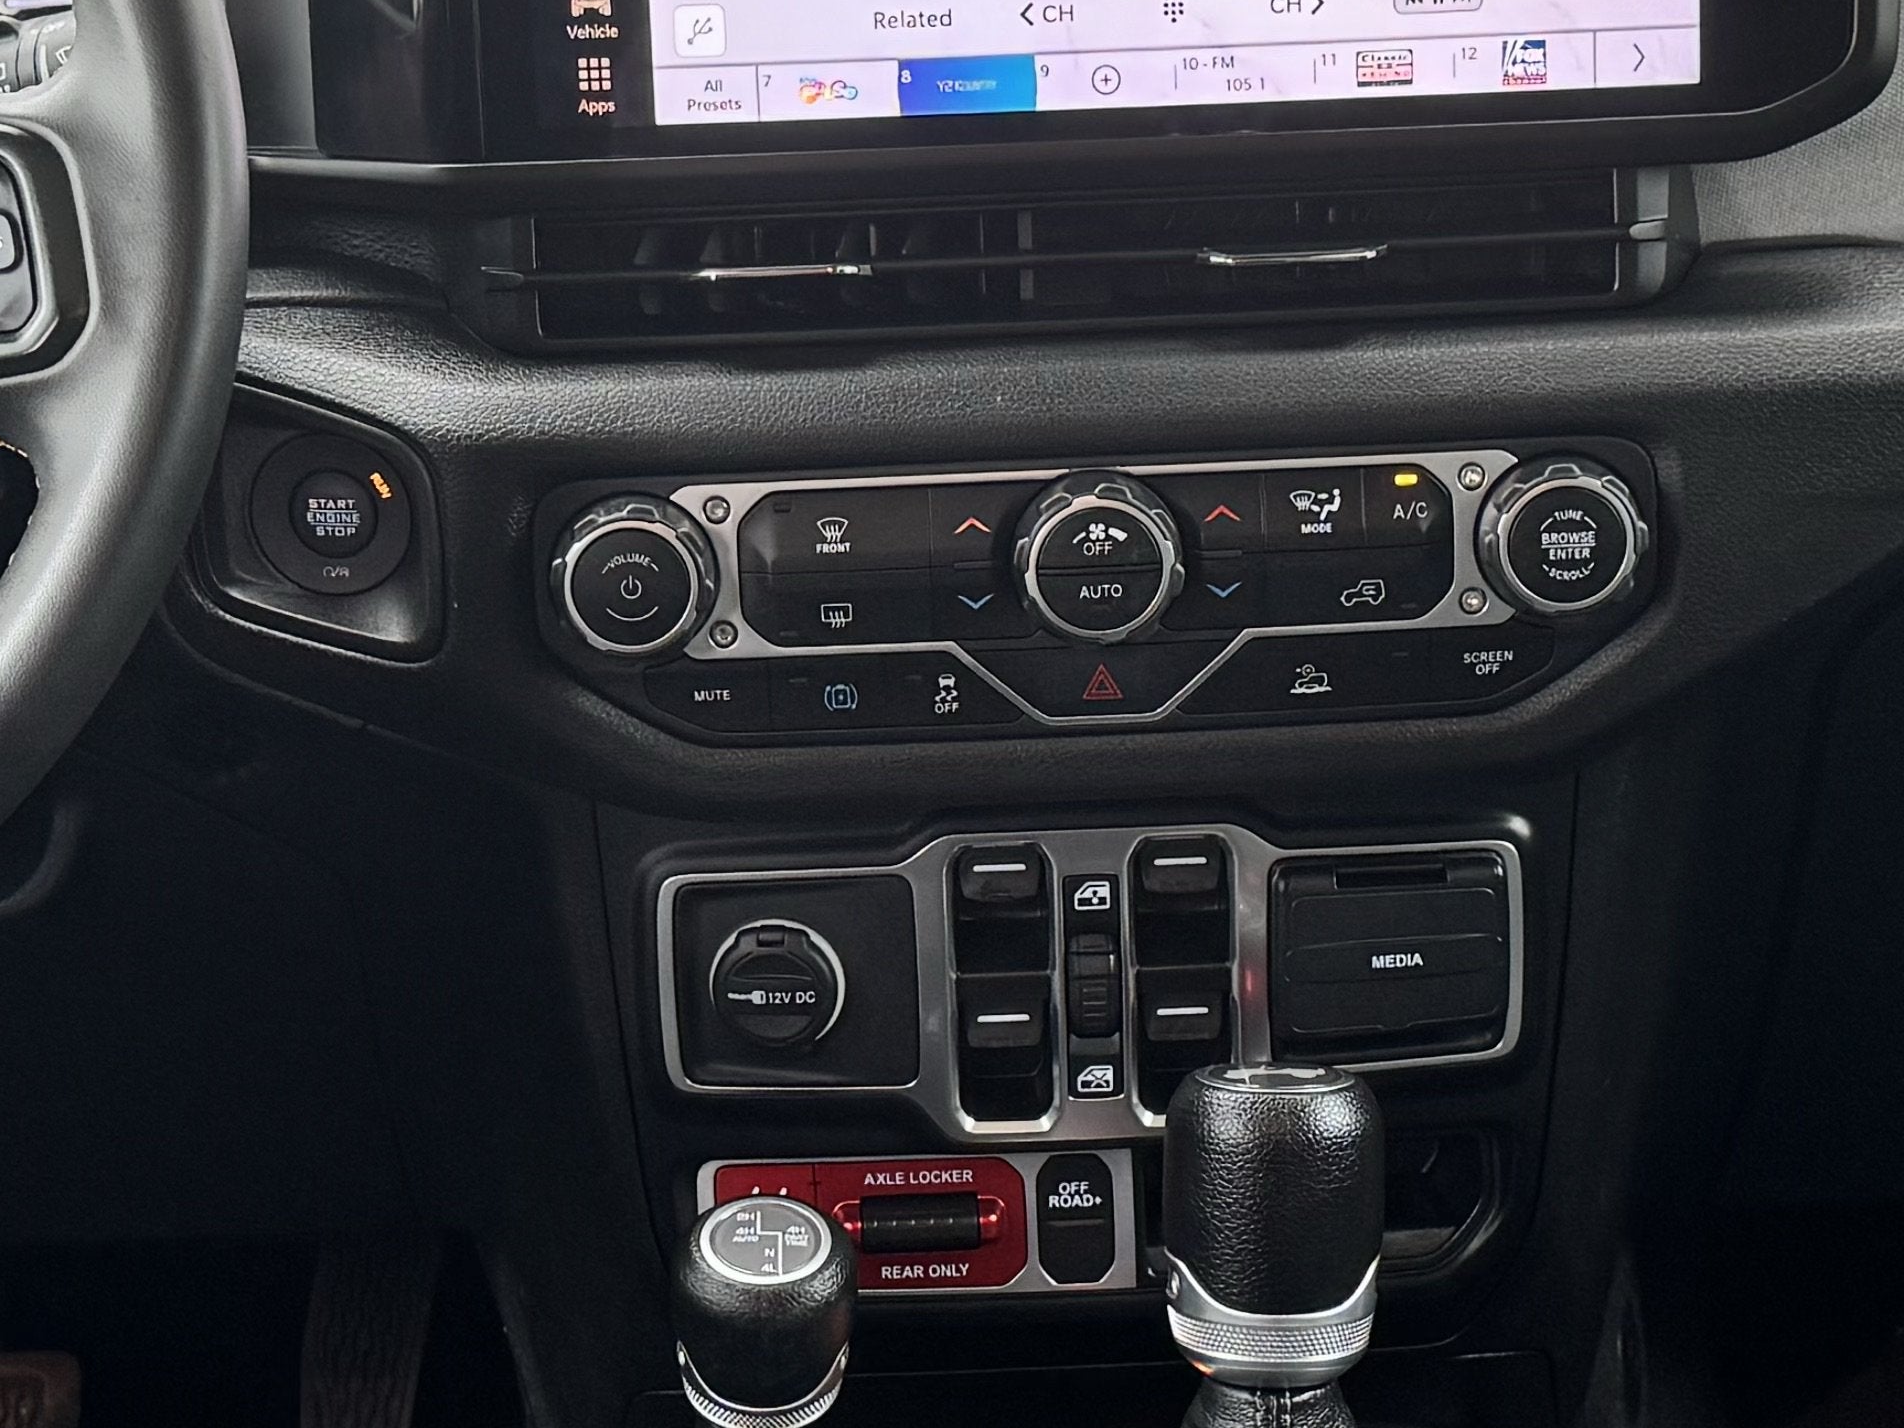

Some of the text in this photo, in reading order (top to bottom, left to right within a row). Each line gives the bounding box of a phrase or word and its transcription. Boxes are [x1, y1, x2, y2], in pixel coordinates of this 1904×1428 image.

[874, 9, 953, 31] Related
[1042, 4, 1075, 24] CH
[566, 24, 619, 40] Vehicle
[1321, 53, 1337, 67] 11
[1461, 47, 1478, 60] 12
[1182, 57, 1199, 71] 10
[1212, 55, 1235, 70] FM
[900, 69, 912, 83] 8
[1040, 64, 1050, 78] 9
[704, 79, 723, 93] All
[762, 74, 772, 88] 7
[578, 98, 616, 115] Apps
[687, 97, 742, 112] Presets
[308, 498, 356, 510] START
[1392, 502, 1428, 520] A/C
[307, 511, 361, 524] ENGINE
[1553, 509, 1585, 521] TUNE
[315, 526, 357, 537] STOP
[1301, 522, 1333, 535] MODE
[1542, 531, 1596, 545] BROWSE
[816, 542, 852, 555] FRONT
[1083, 542, 1113, 556] OFF
[1549, 547, 1591, 561] ENTER
[608, 553, 653, 569] VOLUME
[1548, 567, 1591, 581] SCROLL
[1079, 583, 1123, 600] AUTO
[1463, 650, 1514, 664] SCREEN
[1475, 663, 1501, 676] OFF
[694, 689, 732, 702] MUTE
[934, 701, 960, 715] OFF
[1371, 950, 1424, 970] MEDIA
[768, 991, 816, 1004] 12V DC
[863, 1168, 974, 1185] AXLE LOCKER
[1058, 1180, 1090, 1197] OFF
[764, 1248, 775, 1258] N
[760, 1263, 778, 1273] 4L
[880, 1262, 970, 1280] REAR ONLY
